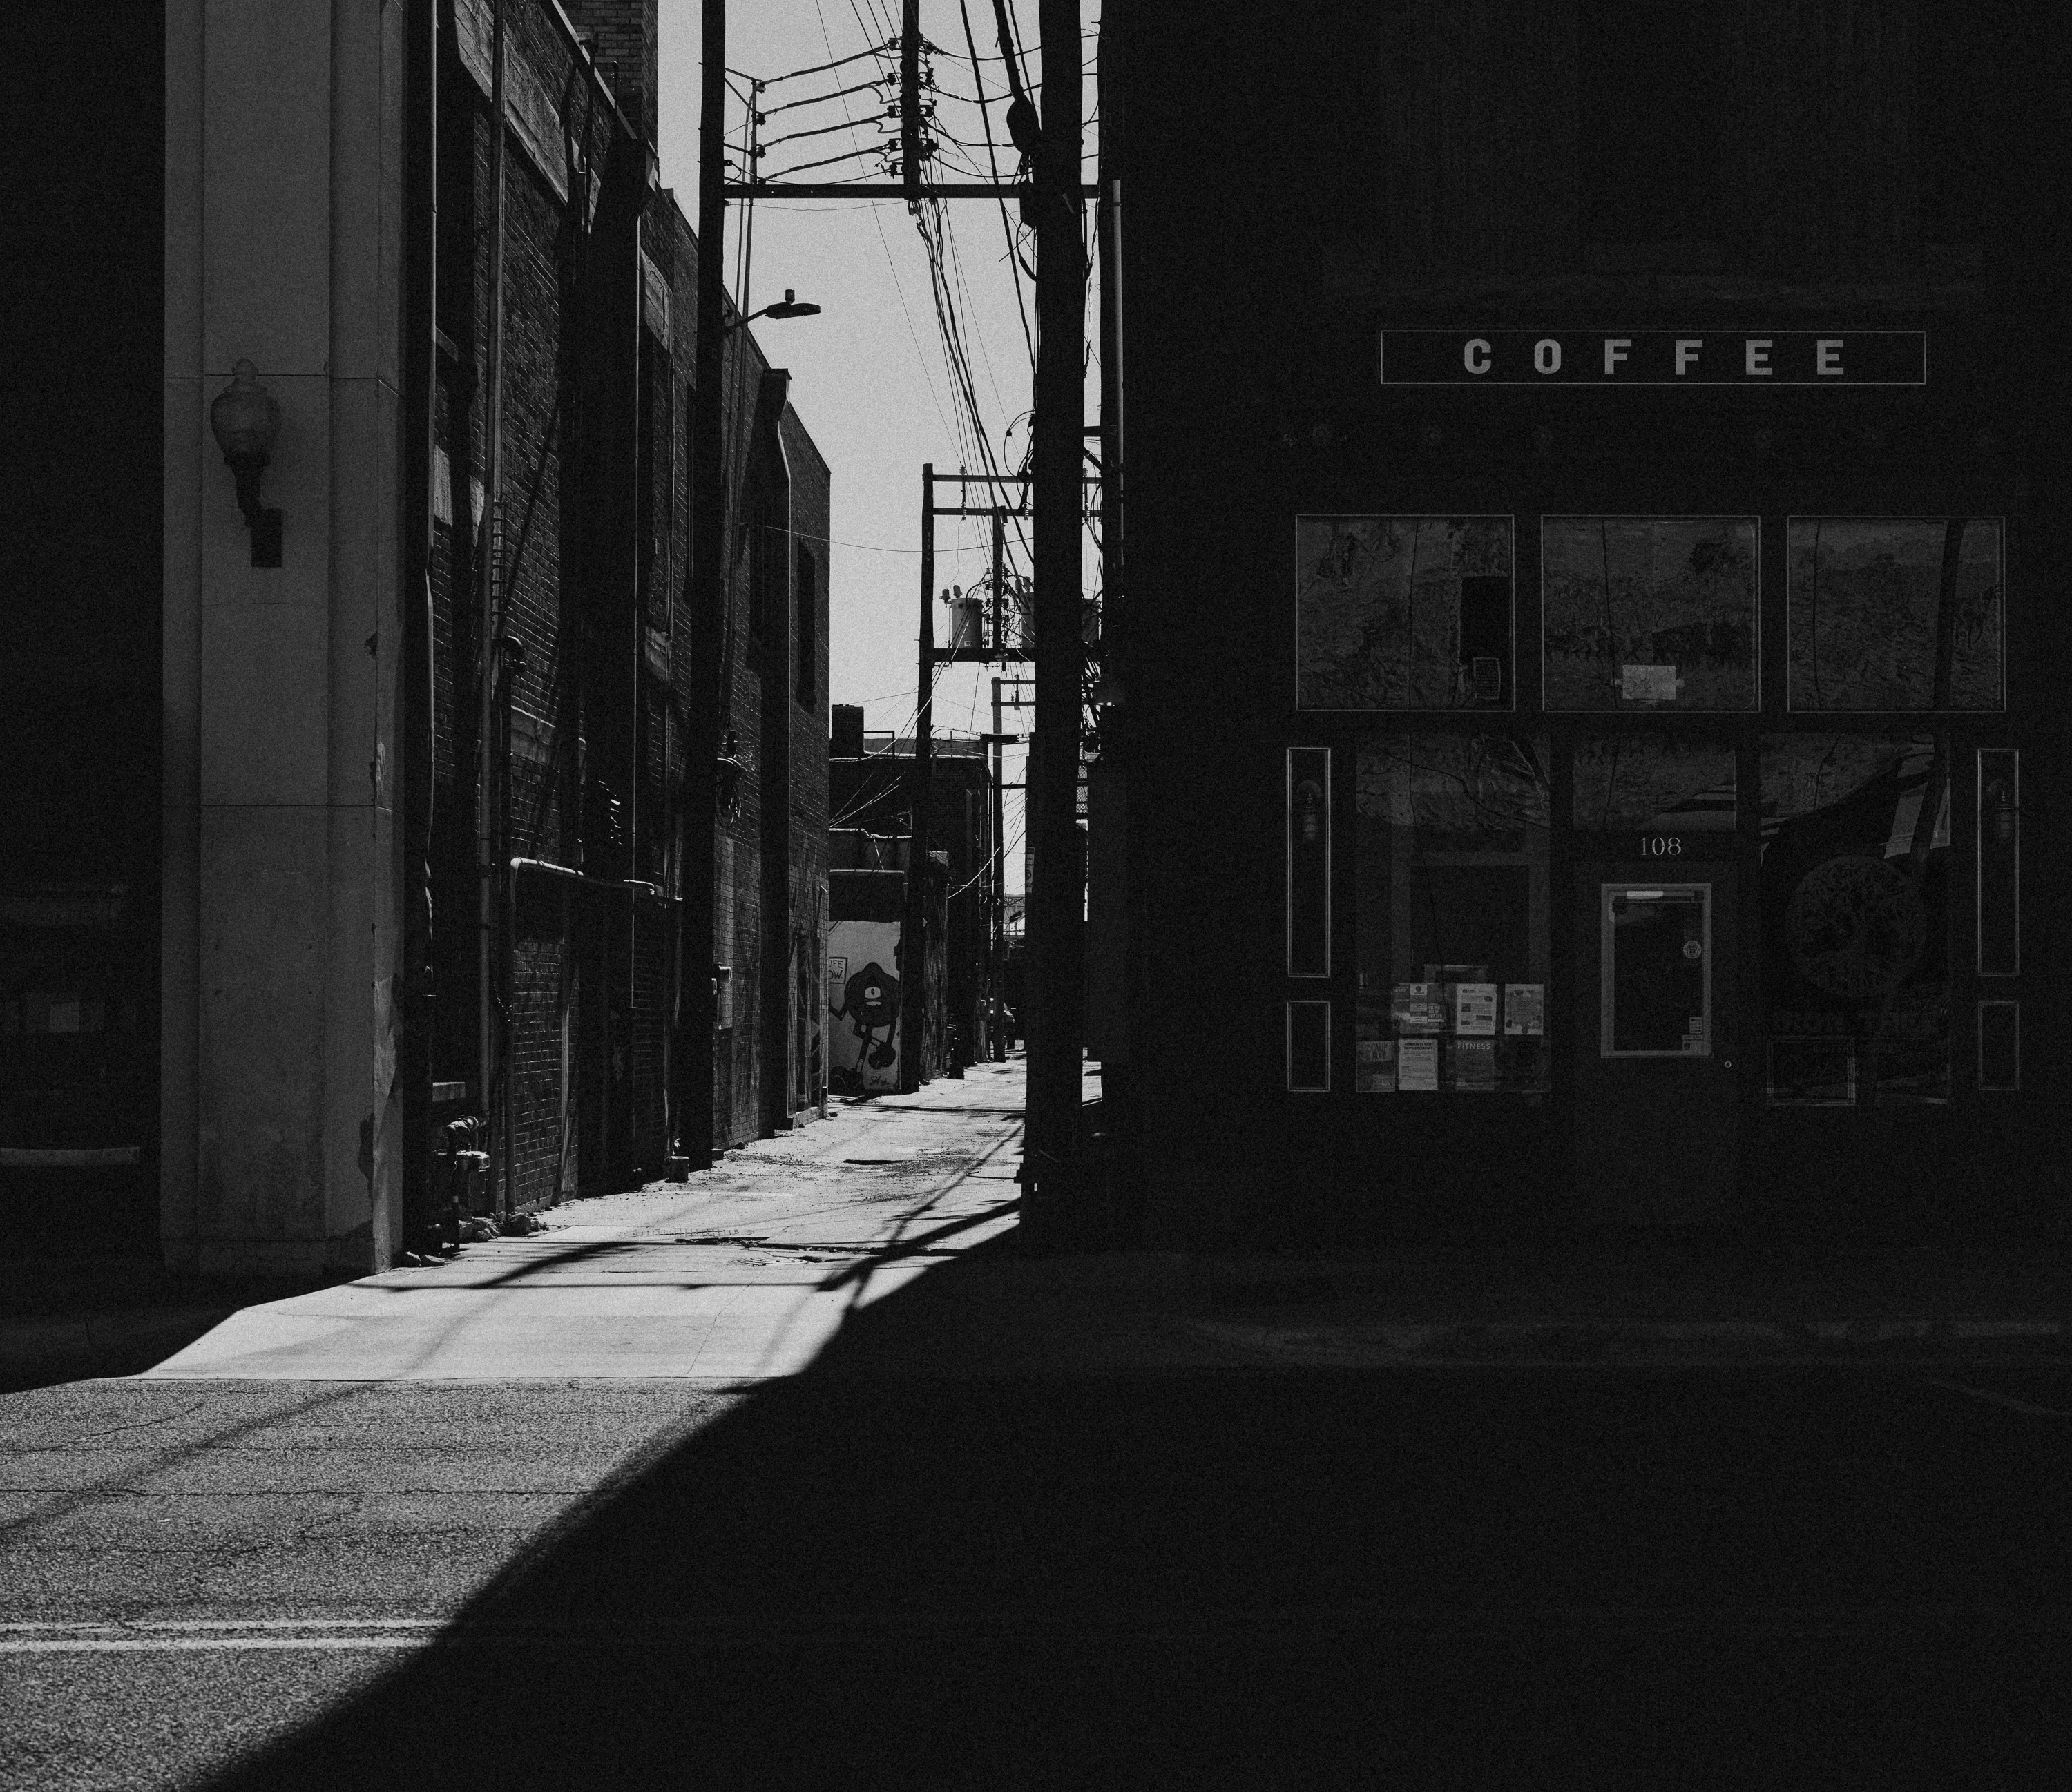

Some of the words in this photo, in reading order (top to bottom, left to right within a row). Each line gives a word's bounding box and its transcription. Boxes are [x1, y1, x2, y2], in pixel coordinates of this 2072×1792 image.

[1464, 338, 1844, 375] COFFEE
[1641, 837, 1682, 856] 108
[1457, 1042, 1492, 1050] FITNESS
